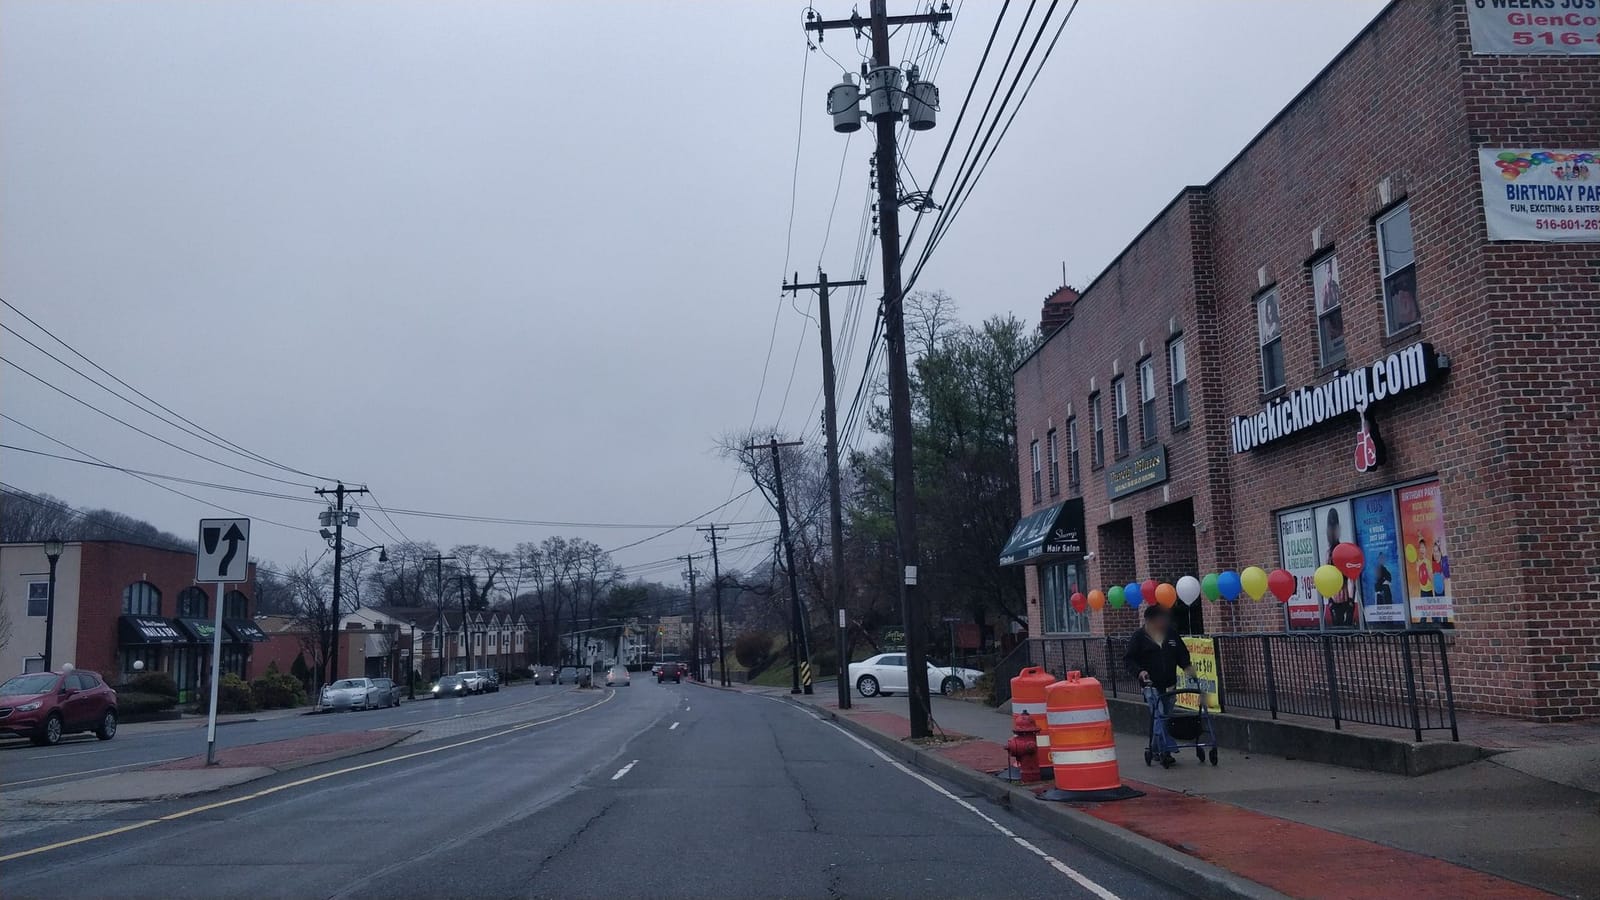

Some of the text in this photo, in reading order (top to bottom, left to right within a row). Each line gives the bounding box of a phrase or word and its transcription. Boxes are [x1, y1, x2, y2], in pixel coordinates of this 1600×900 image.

[1493, 0, 1555, 8] WEEKS
[1561, 0, 1600, 9] JUS
[1507, 12, 1600, 26] GlenCo
[1512, 31, 1600, 45] 516-
[1506, 184, 1573, 201] BIRTHDAY
[1510, 204, 1528, 214] FUN,
[1530, 204, 1566, 213] EXCITING
[1567, 205, 1573, 213] &
[1536, 219, 1600, 230] 516-801-26
[1230, 343, 1426, 453] ilovekickboxing.com
[1303, 517, 1312, 532] FAT
[1047, 544, 1060, 553] Hair
[1062, 544, 1080, 552] Salon
[1291, 537, 1313, 556] CLASSES
